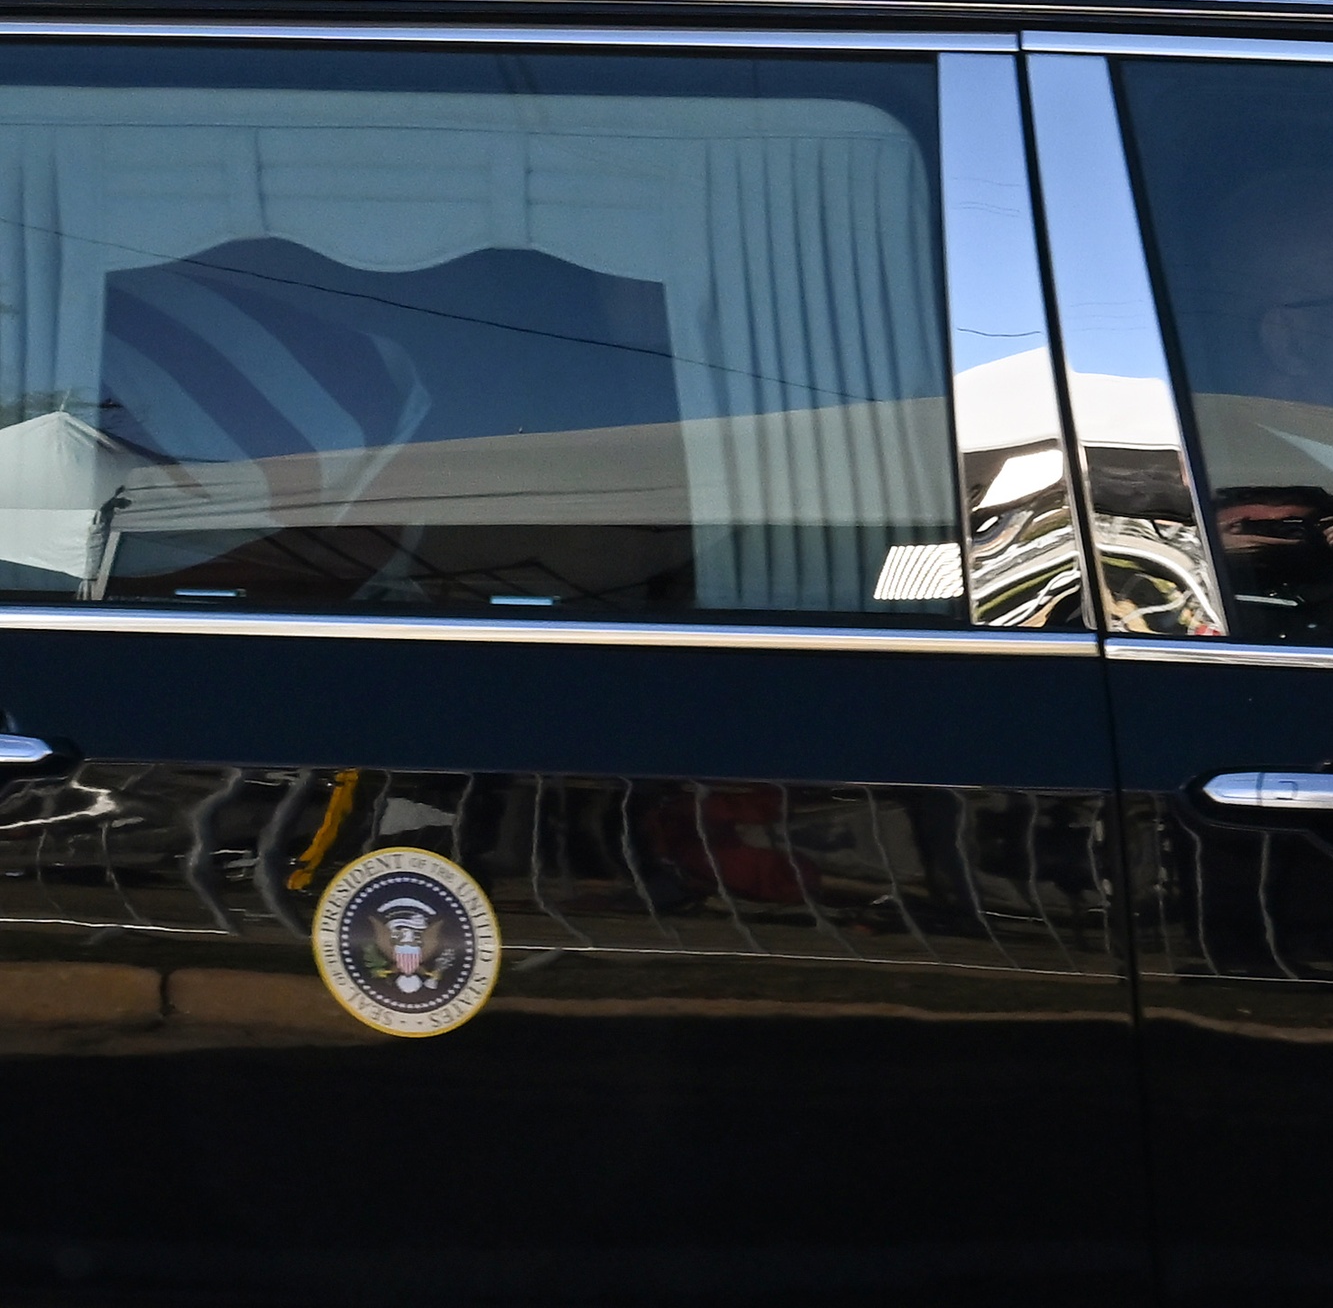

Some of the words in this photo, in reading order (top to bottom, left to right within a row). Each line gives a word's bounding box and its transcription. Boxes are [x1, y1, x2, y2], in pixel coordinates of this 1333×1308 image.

[408, 856, 428, 869] OF
[320, 854, 404, 933] PRESIDENT
[457, 881, 493, 963] UNITED
[348, 991, 394, 1027] SEAL
[430, 972, 488, 1028] STATES
